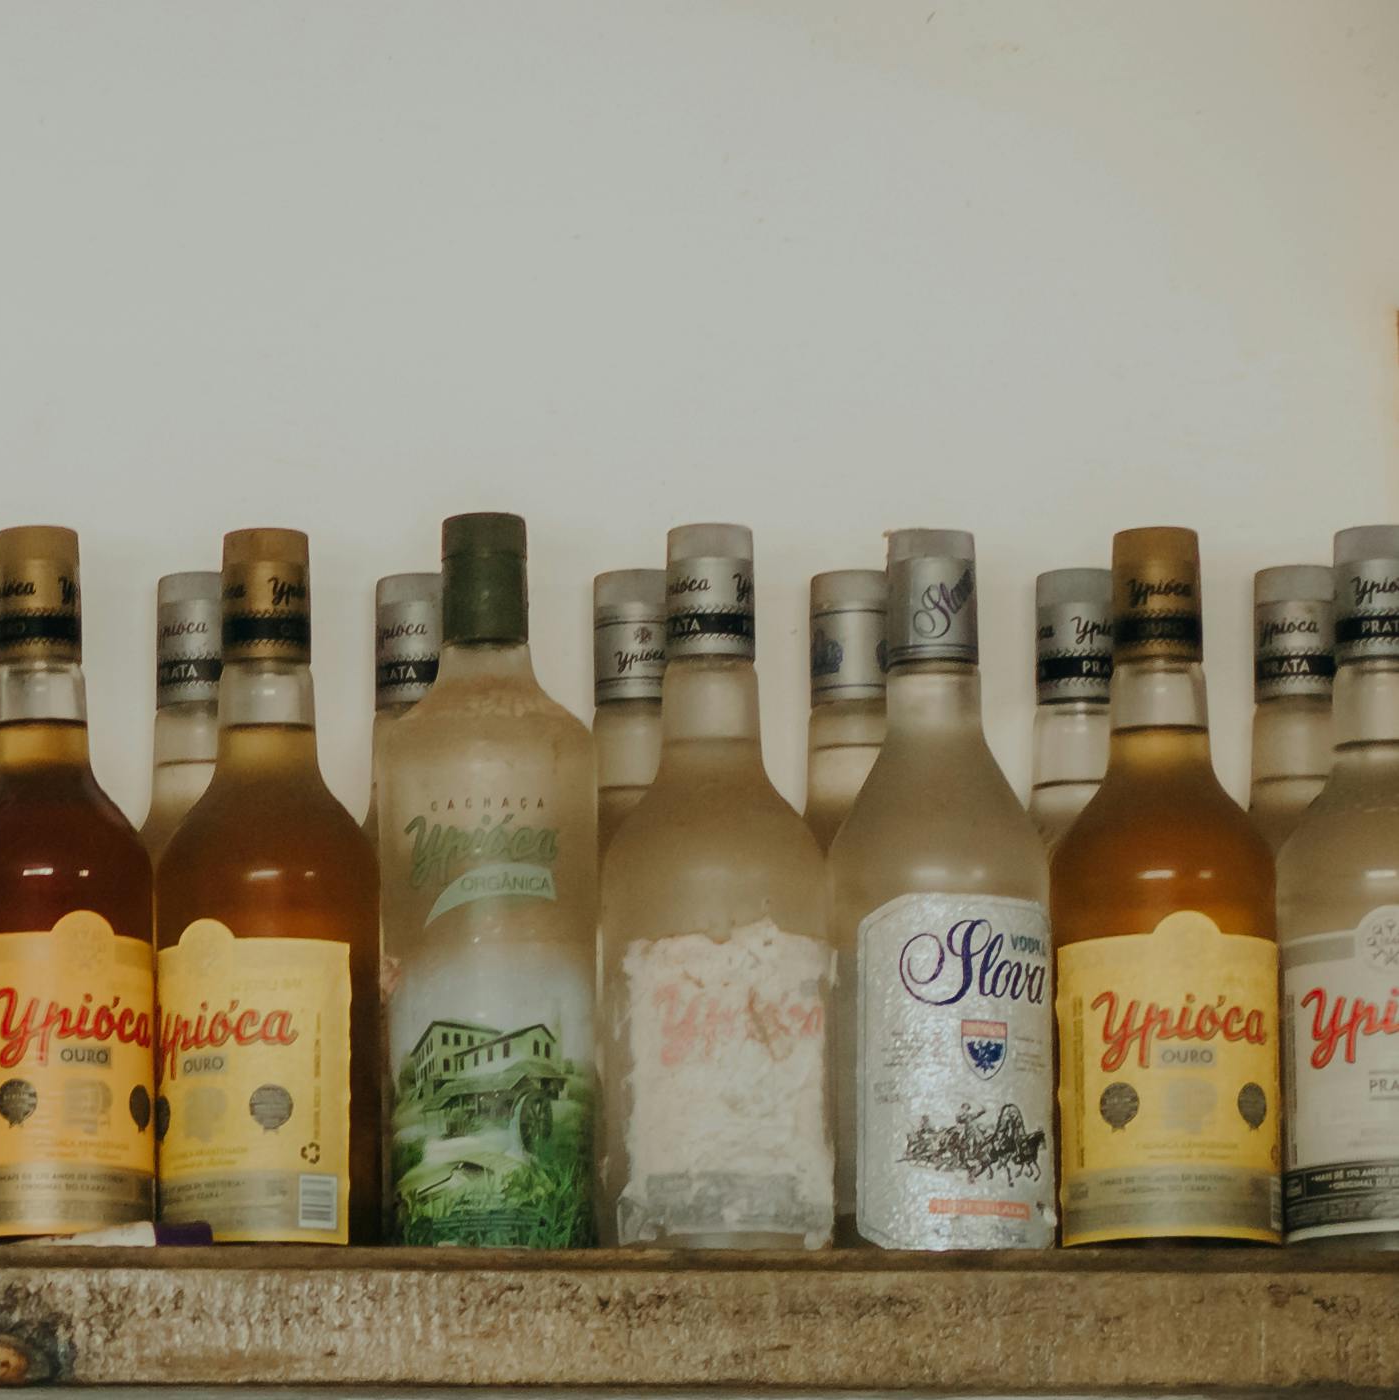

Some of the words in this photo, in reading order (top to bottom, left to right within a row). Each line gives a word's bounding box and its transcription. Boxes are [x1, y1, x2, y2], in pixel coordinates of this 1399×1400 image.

[430, 796, 546, 814] CACHAÇA
[459, 870, 552, 893] ORGÂNICA
[899, 919, 1046, 1006] Slova
[1092, 991, 1267, 1073] Ypióca
[60, 1046, 110, 1064] OURO
[1160, 1048, 1214, 1065] OURO
[183, 1056, 225, 1074] OURO
